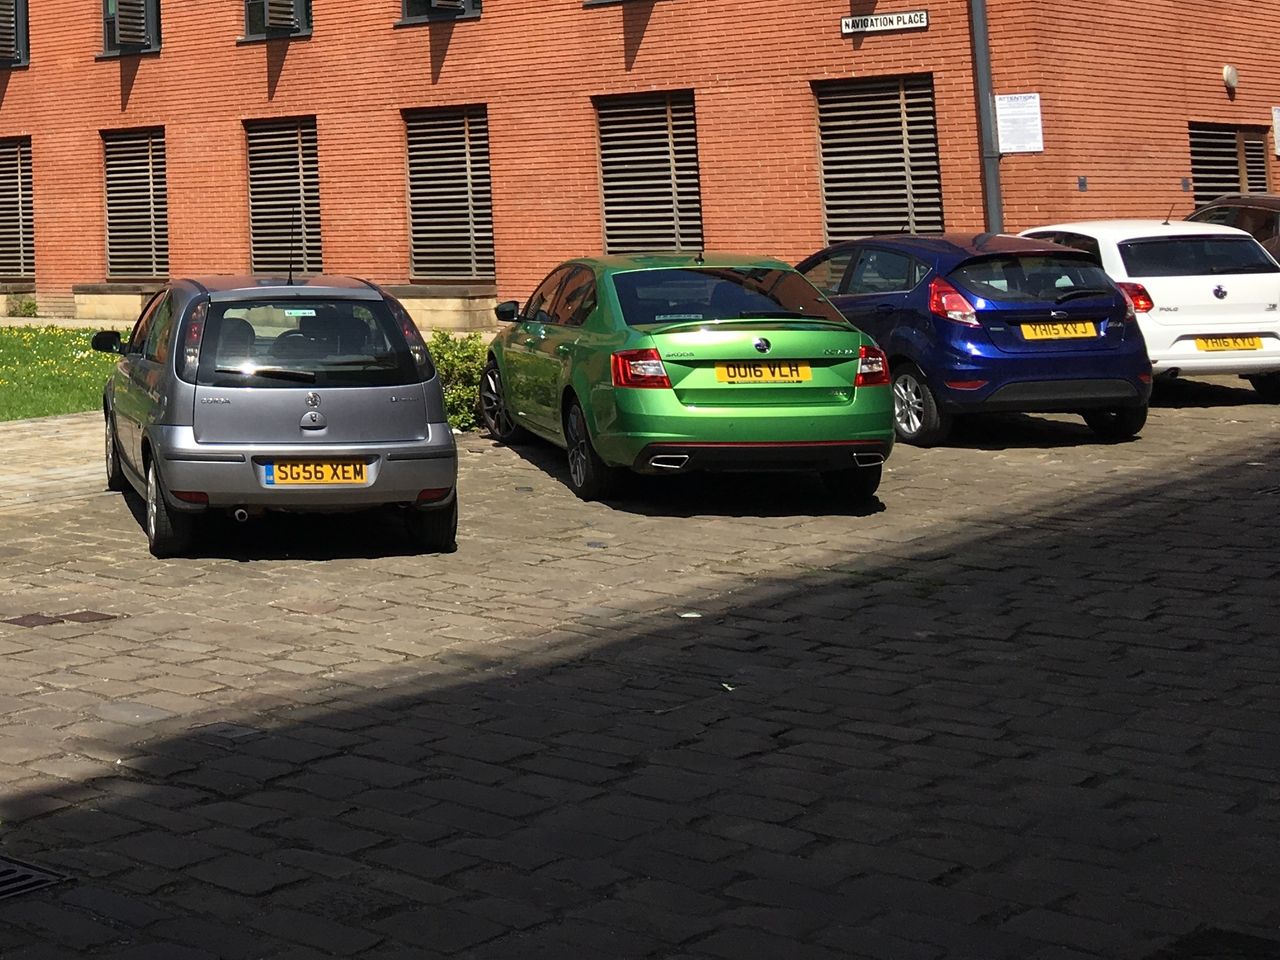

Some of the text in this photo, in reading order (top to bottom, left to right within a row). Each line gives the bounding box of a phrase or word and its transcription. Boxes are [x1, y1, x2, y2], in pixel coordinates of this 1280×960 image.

[844, 13, 925, 30] NAVIGATION PLACE
[1029, 321, 1089, 336] YH15 KVJ
[1202, 335, 1257, 349] YH16 KYU
[726, 361, 800, 379] OU16 VLH
[277, 463, 364, 481] SG56 XEM
